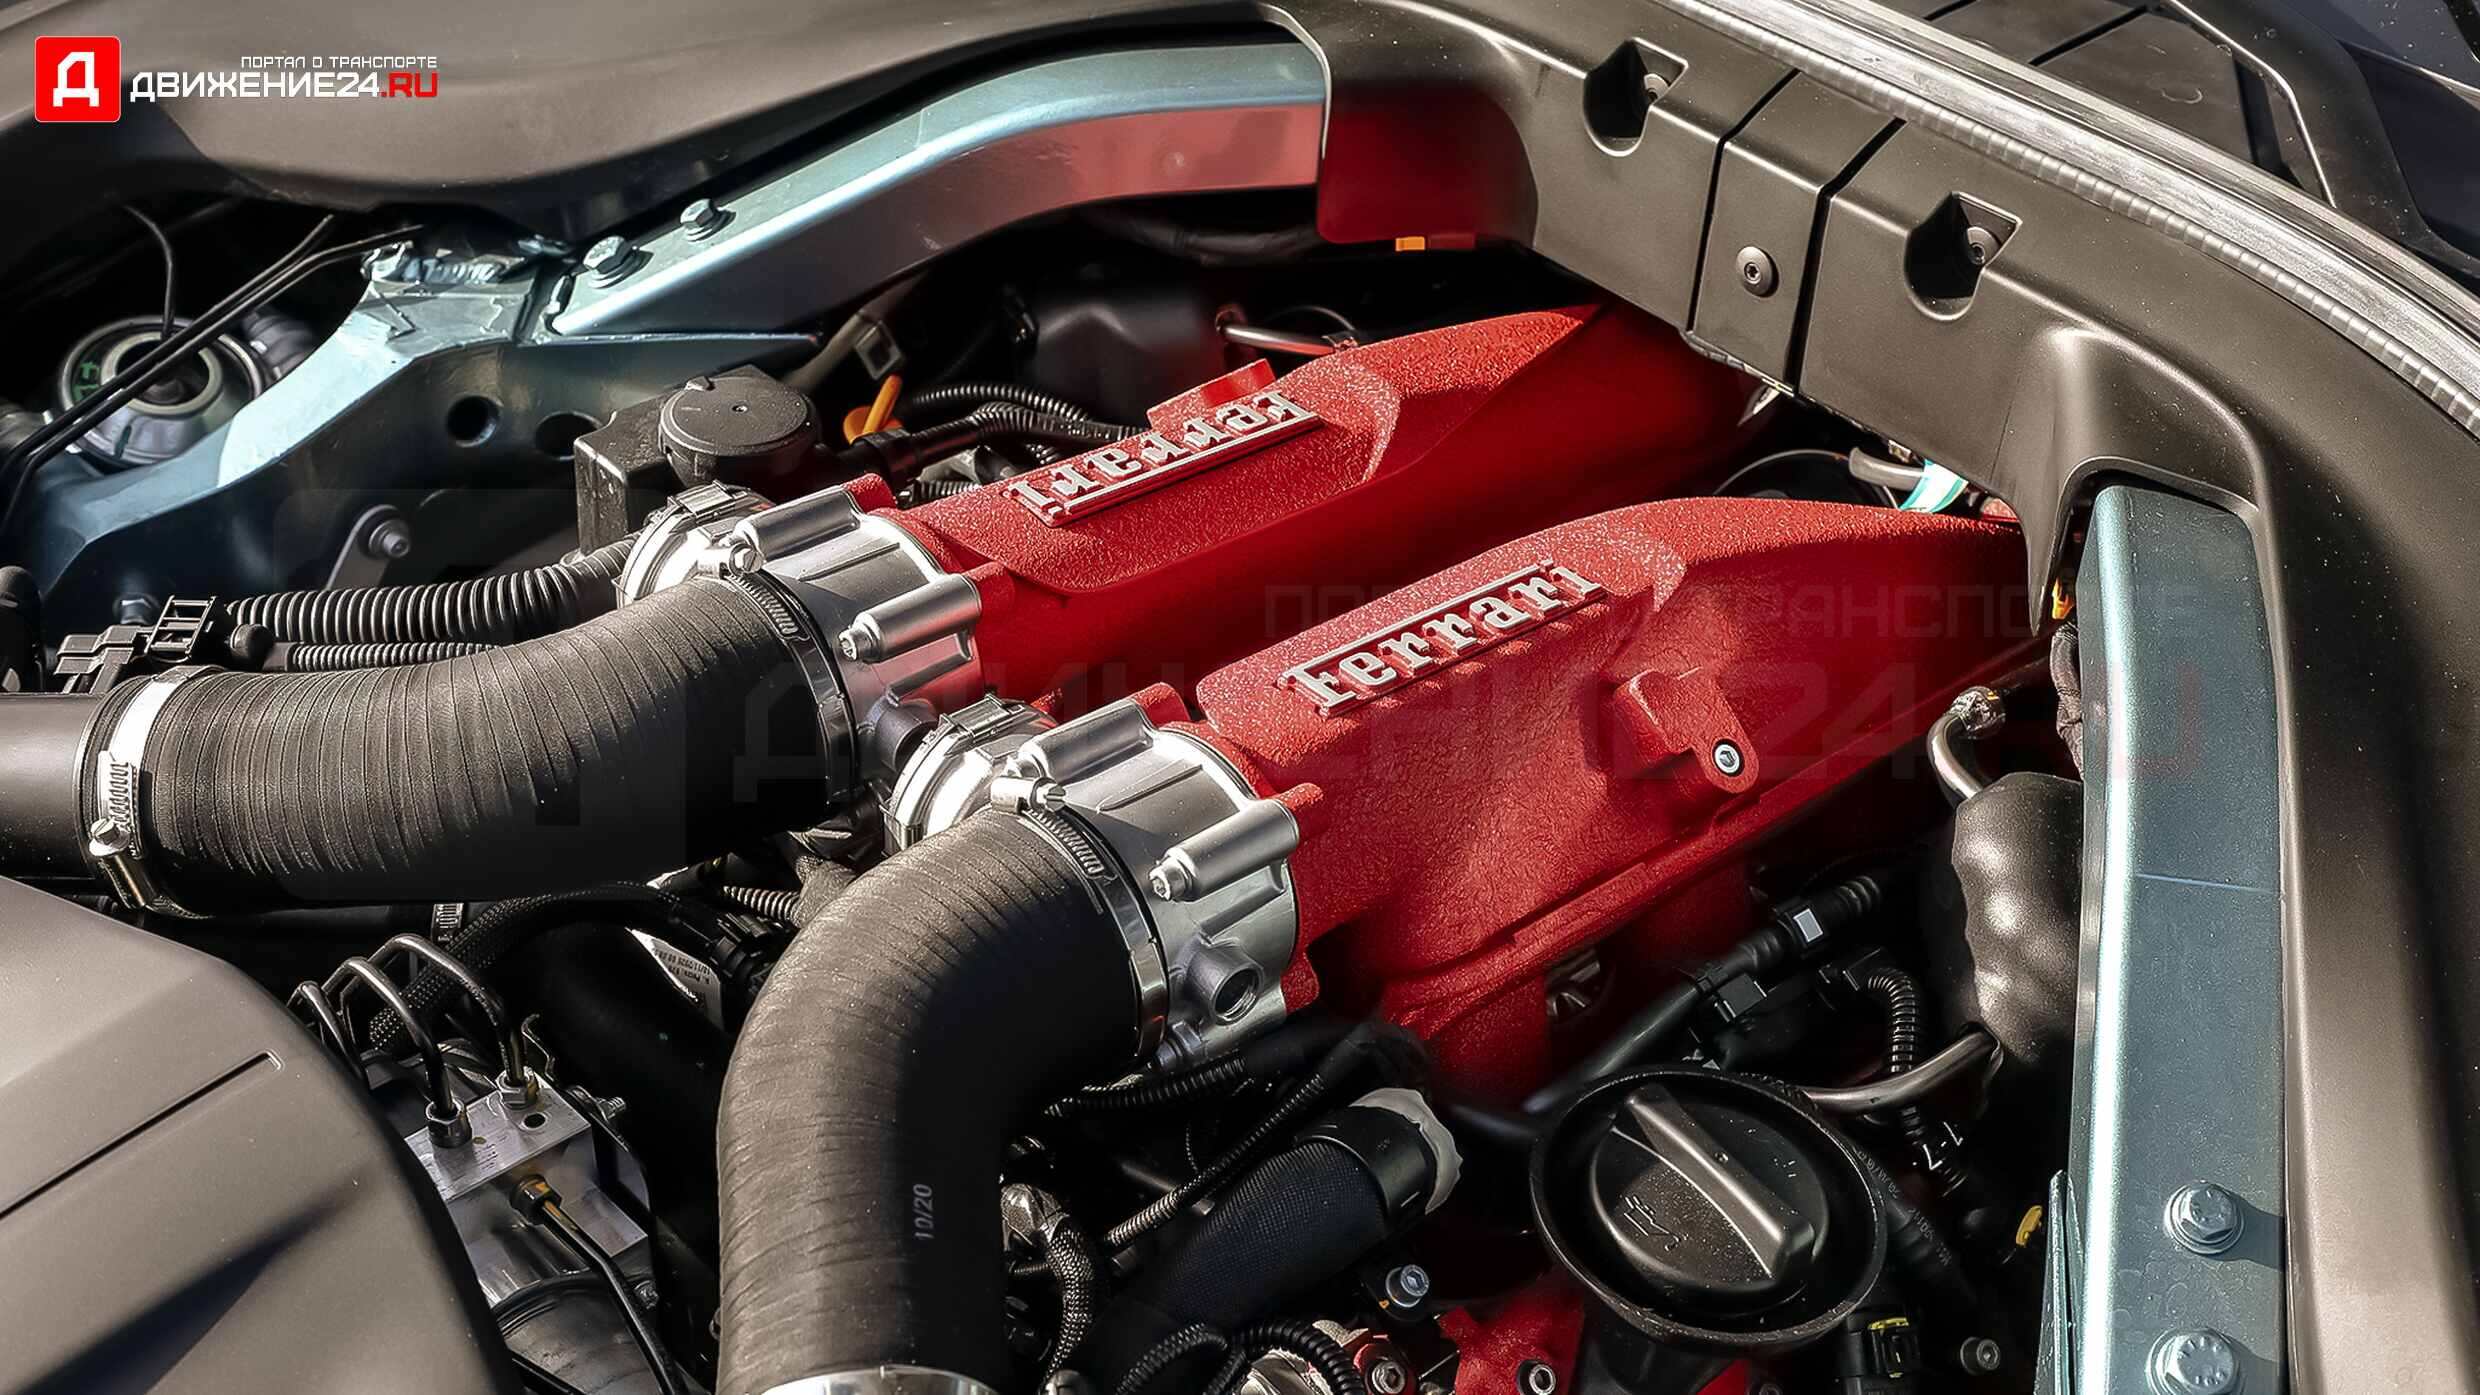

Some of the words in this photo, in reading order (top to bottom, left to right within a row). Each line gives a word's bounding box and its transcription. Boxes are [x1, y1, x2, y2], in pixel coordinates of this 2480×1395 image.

[1003, 391, 1320, 516] Ferrari
[1278, 559, 1602, 714] Ferrari
[912, 1183, 935, 1239] 10/20
